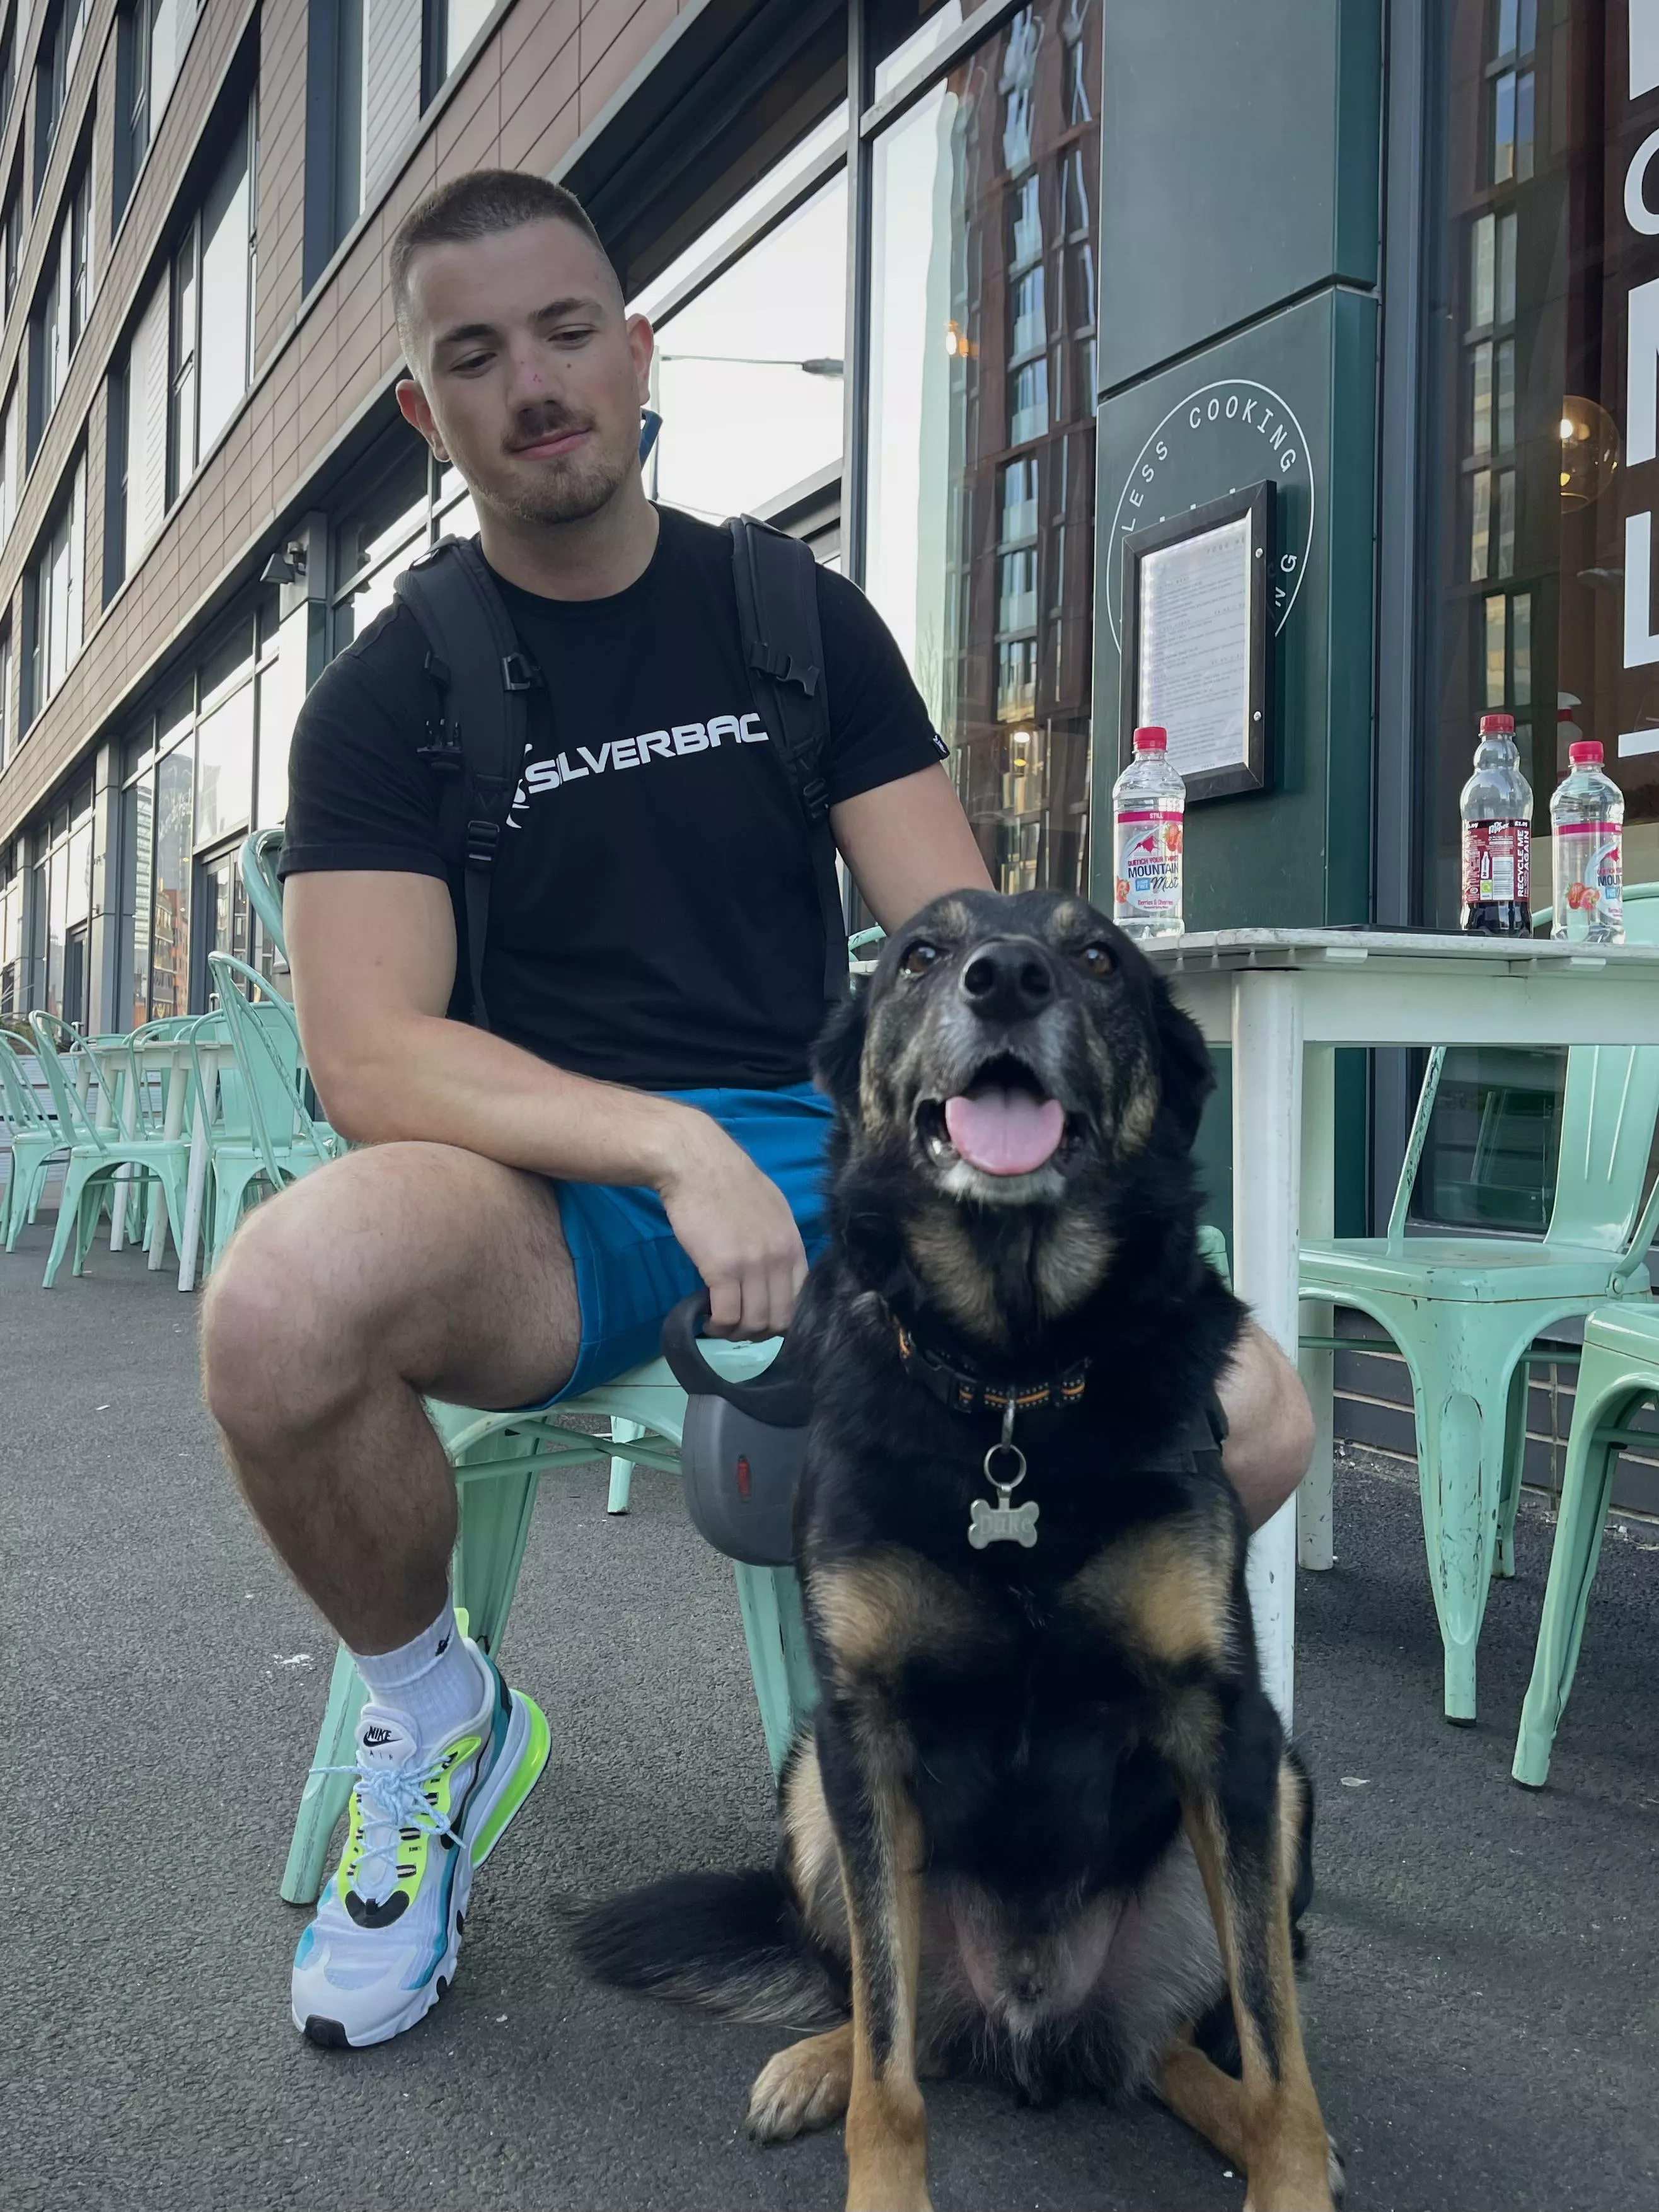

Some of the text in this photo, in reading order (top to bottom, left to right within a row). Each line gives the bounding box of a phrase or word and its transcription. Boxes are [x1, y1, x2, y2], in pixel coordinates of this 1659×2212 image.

[1121, 395, 1297, 532] LESS COOKING
[1517, 830, 1524, 847] ME
[1128, 862, 1179, 879] MOUNTAIN
[1150, 876, 1179, 892] Mist
[980, 1514, 1032, 1535] Duke
[367, 1725, 392, 1742] NIKE
